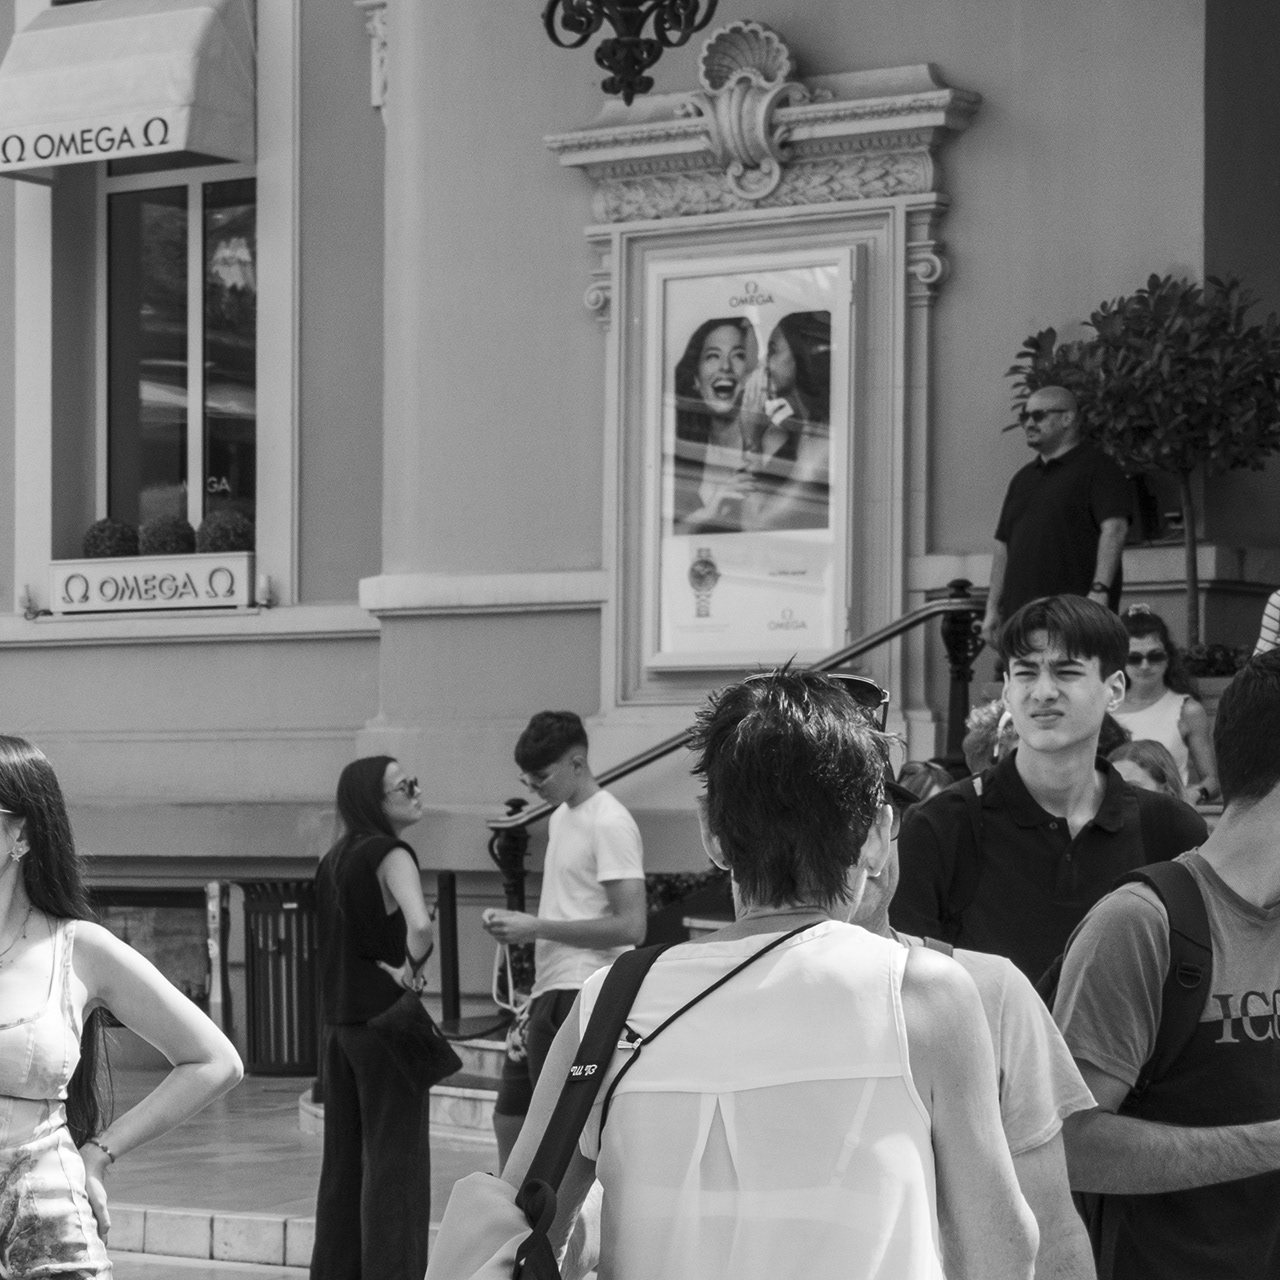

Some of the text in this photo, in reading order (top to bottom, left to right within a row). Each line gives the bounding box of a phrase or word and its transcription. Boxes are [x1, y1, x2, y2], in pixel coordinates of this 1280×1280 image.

[33, 126, 136, 160] OMEGA
[729, 294, 774, 308] OMEGA
[99, 573, 199, 602] OMEGA
[1212, 989, 1280, 1043] IC
